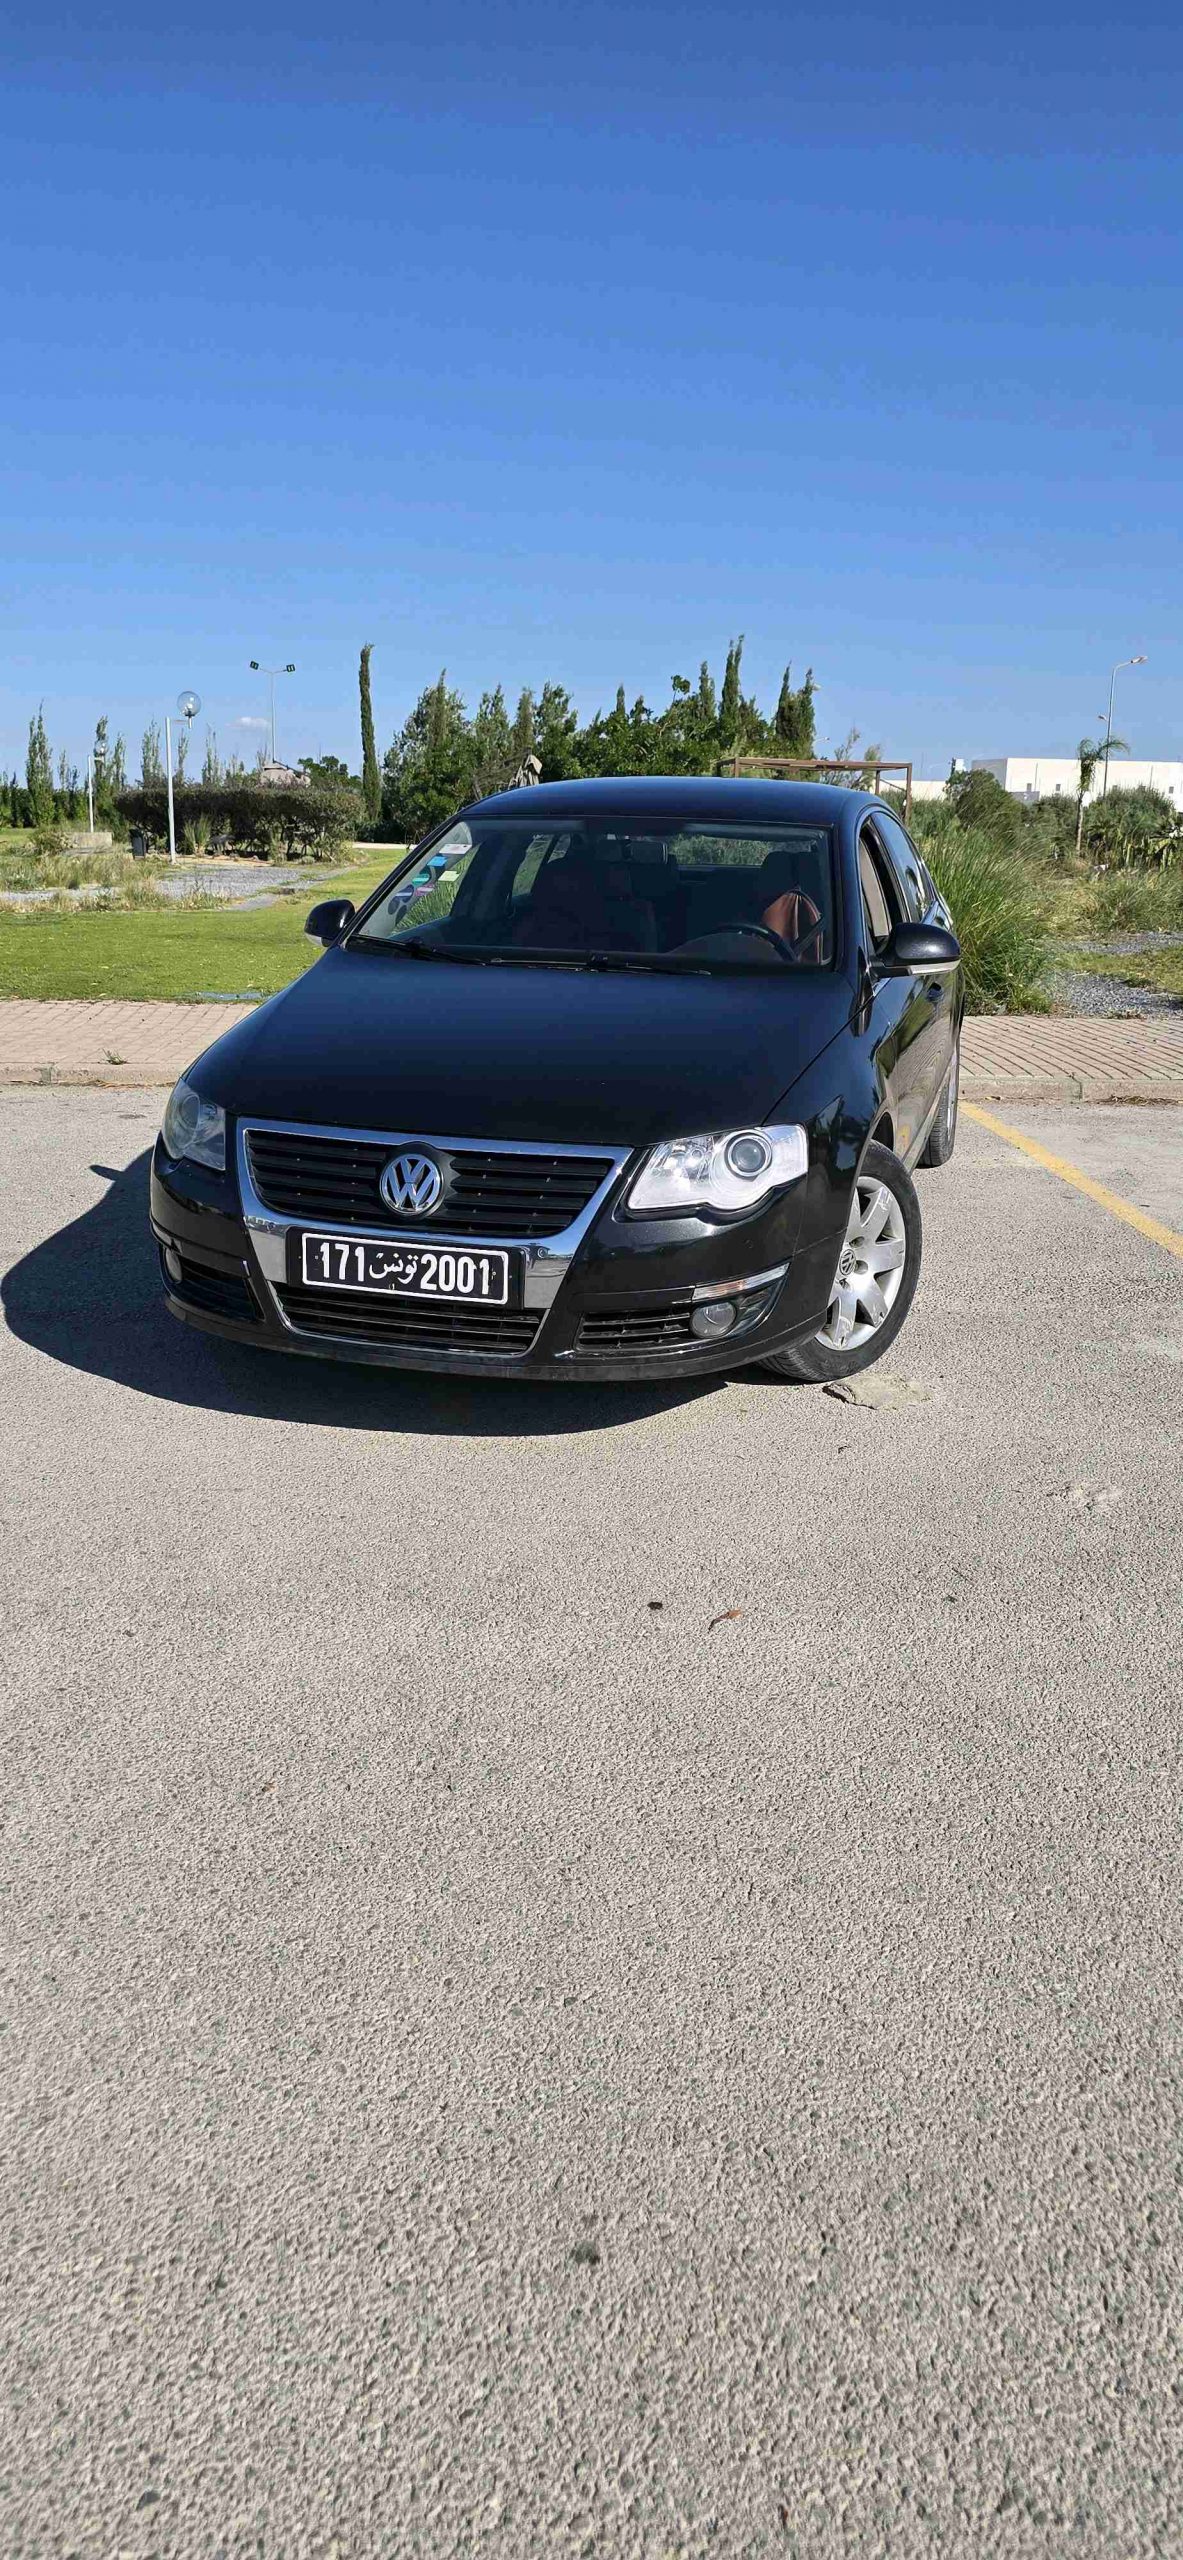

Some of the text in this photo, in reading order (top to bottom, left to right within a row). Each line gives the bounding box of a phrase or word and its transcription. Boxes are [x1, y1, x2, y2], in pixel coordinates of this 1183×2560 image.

[381, 1154, 440, 1213] VW
[320, 1242, 490, 1295] 171 تونس 2001
